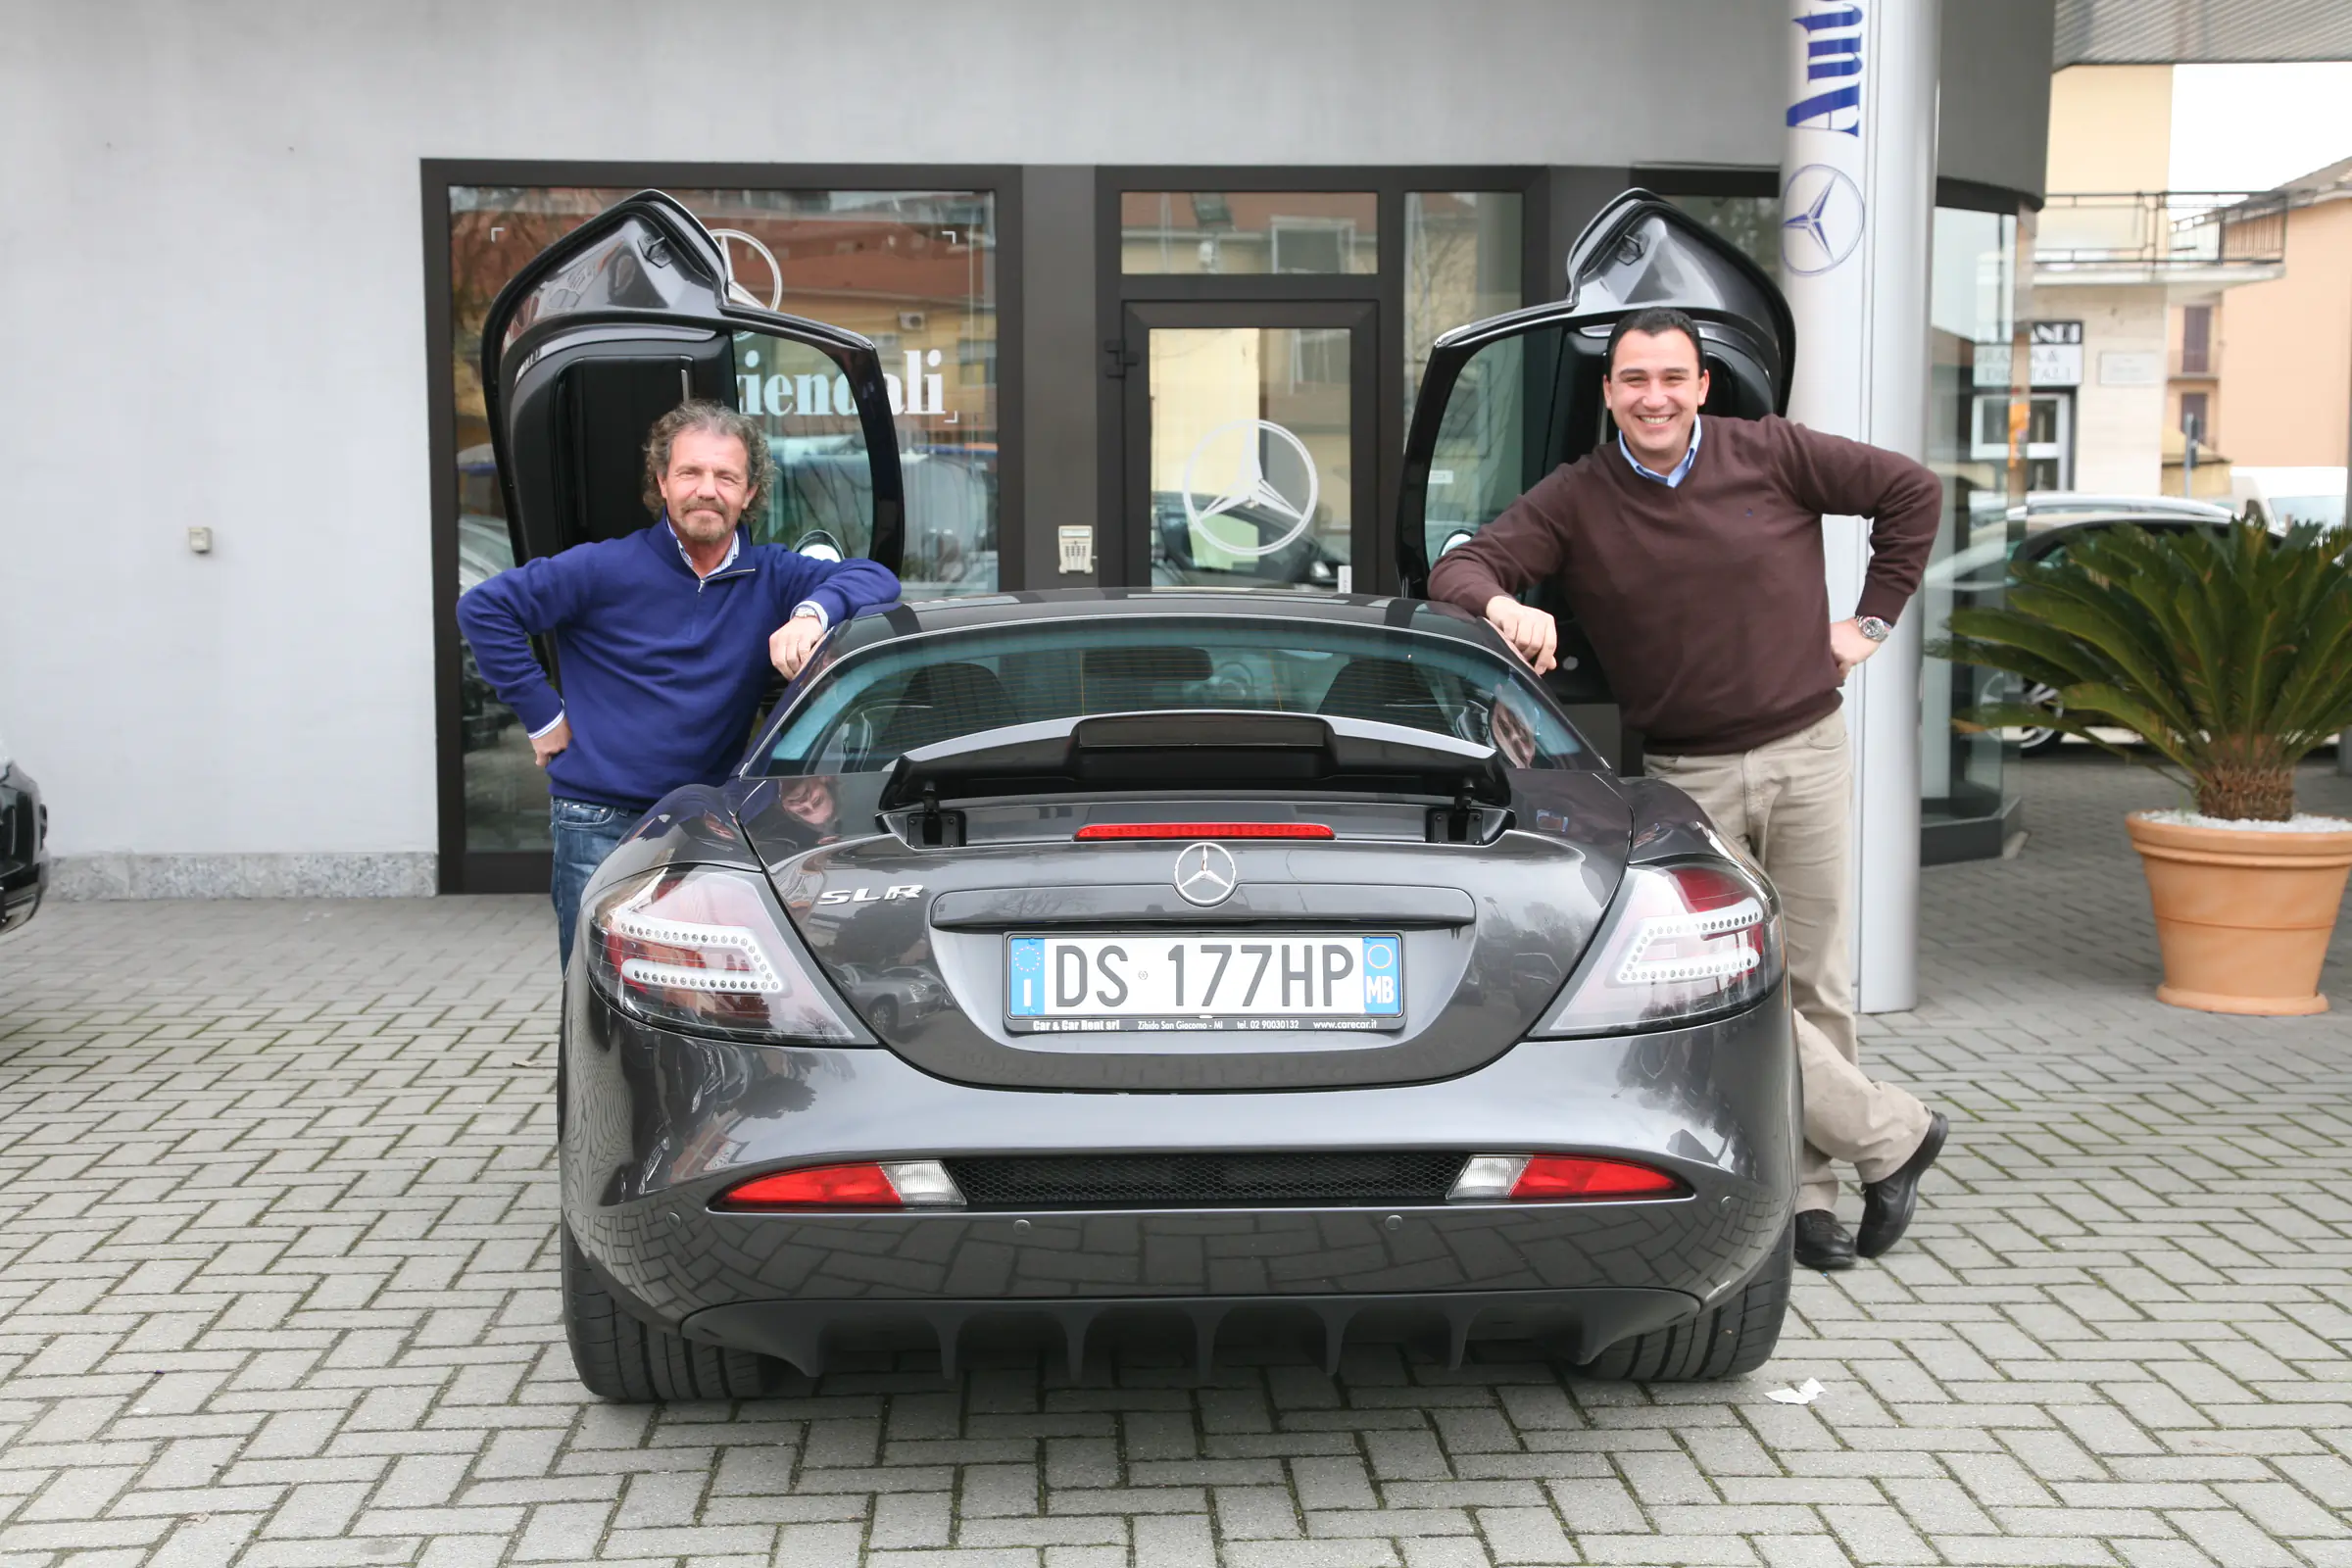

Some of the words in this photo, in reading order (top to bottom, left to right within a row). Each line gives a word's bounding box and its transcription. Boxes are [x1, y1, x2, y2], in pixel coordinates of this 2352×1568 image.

[1787, 0, 1863, 137] Aut
[736, 349, 946, 416] ienali
[817, 885, 924, 906] SLR
[1055, 945, 1129, 1007] DS
[1168, 945, 1354, 1007] 177HP
[1366, 975, 1395, 1004] MB
[1033, 1020, 1051, 1031] Car
[1053, 1021, 1060, 1031] &
[1061, 1020, 1079, 1031] Car
[1081, 1020, 1103, 1031] Rent
[1105, 1020, 1120, 1031] srl
[1138, 1021, 1159, 1030] Zibido
[1161, 1021, 1174, 1030] San
[1176, 1020, 1206, 1030] Giacomo
[1237, 1020, 1249, 1029] tel.
[1250, 1020, 1260, 1030] 02
[1261, 1020, 1299, 1030] 90030132
[1313, 1019, 1377, 1029] www.carecar.it
